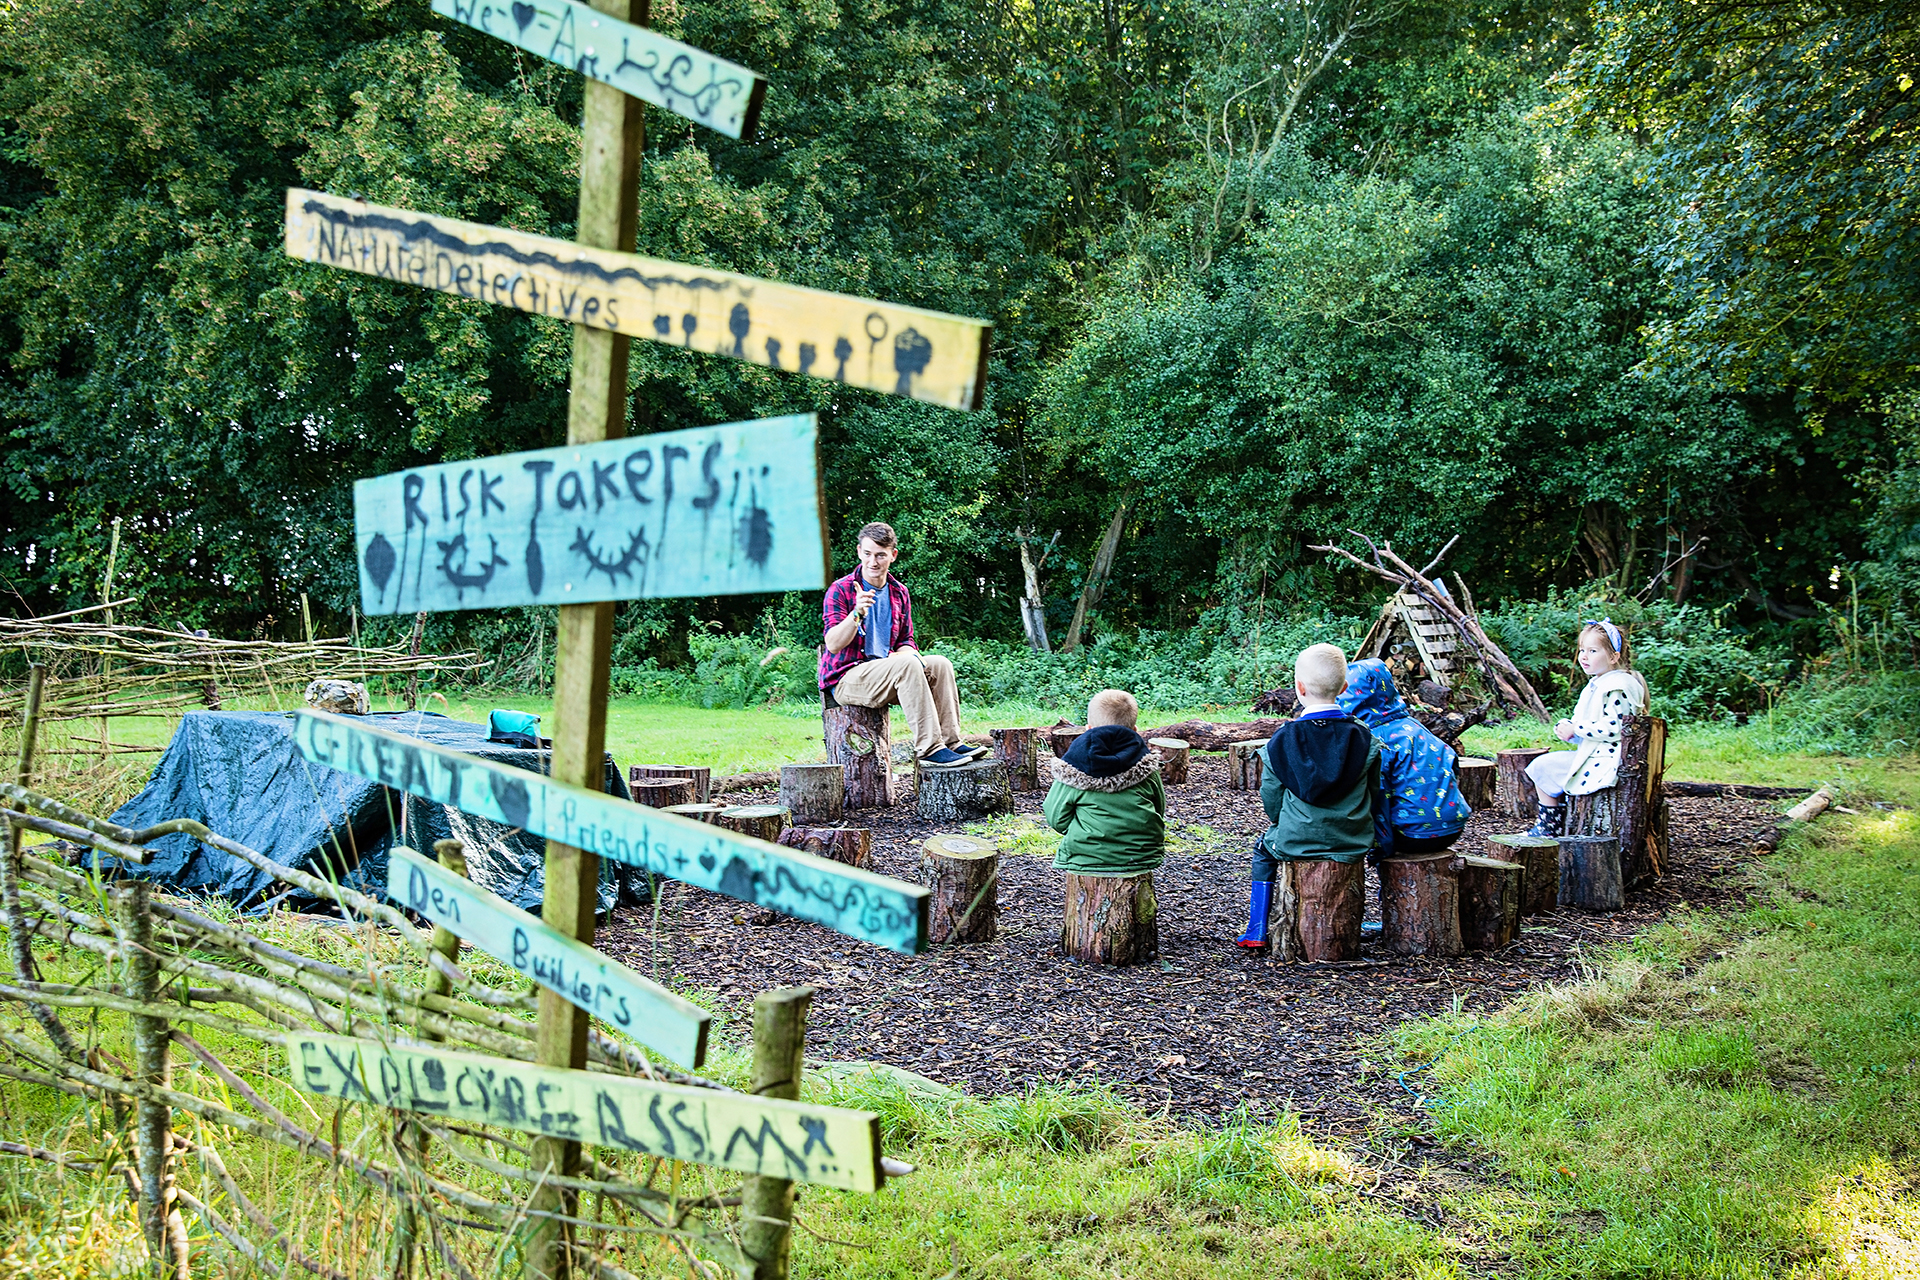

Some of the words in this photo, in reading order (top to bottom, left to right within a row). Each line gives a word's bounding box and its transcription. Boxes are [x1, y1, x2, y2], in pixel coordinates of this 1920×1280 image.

[435, 252, 619, 329] Detectives
[403, 473, 506, 528] RISK
[409, 864, 462, 923] Den
